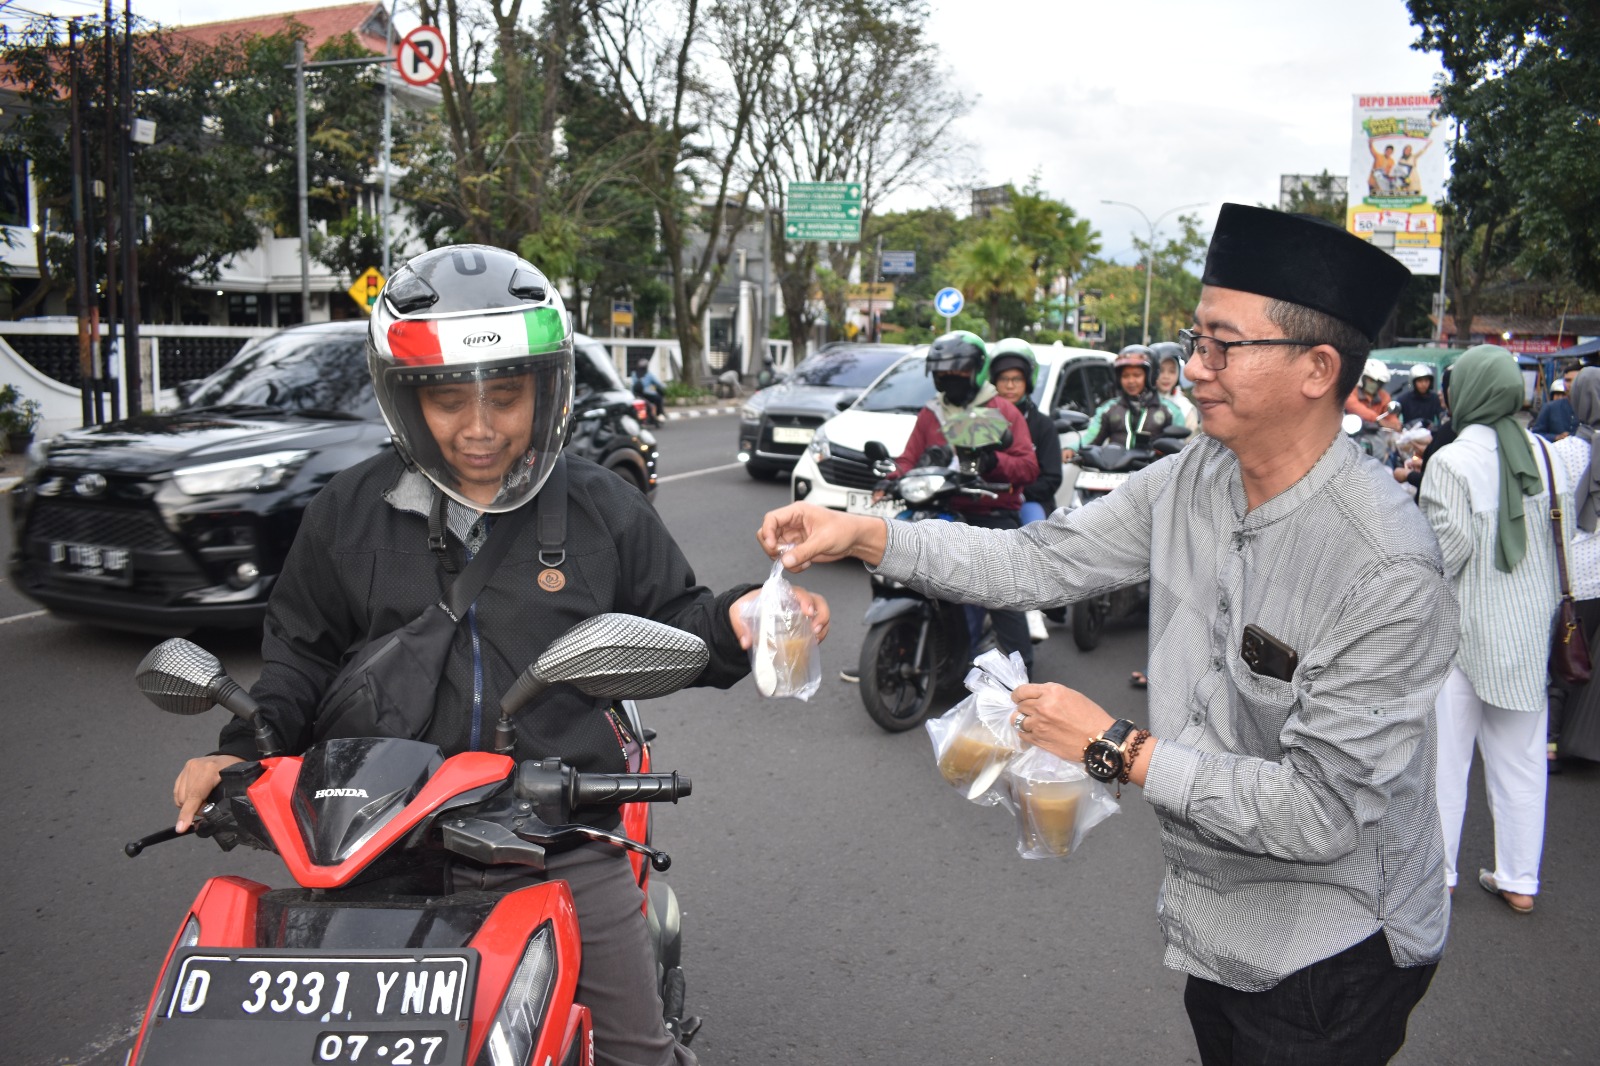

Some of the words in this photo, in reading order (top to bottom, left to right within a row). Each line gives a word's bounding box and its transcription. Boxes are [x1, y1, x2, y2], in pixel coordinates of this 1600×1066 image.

[413, 40, 434, 74] P
[1360, 96, 1385, 107] DEPO
[466, 334, 497, 345] HRV
[314, 788, 369, 799] HONDA
[180, 970, 211, 1012] D
[242, 970, 350, 1014] 3331
[376, 971, 458, 1014] YNN
